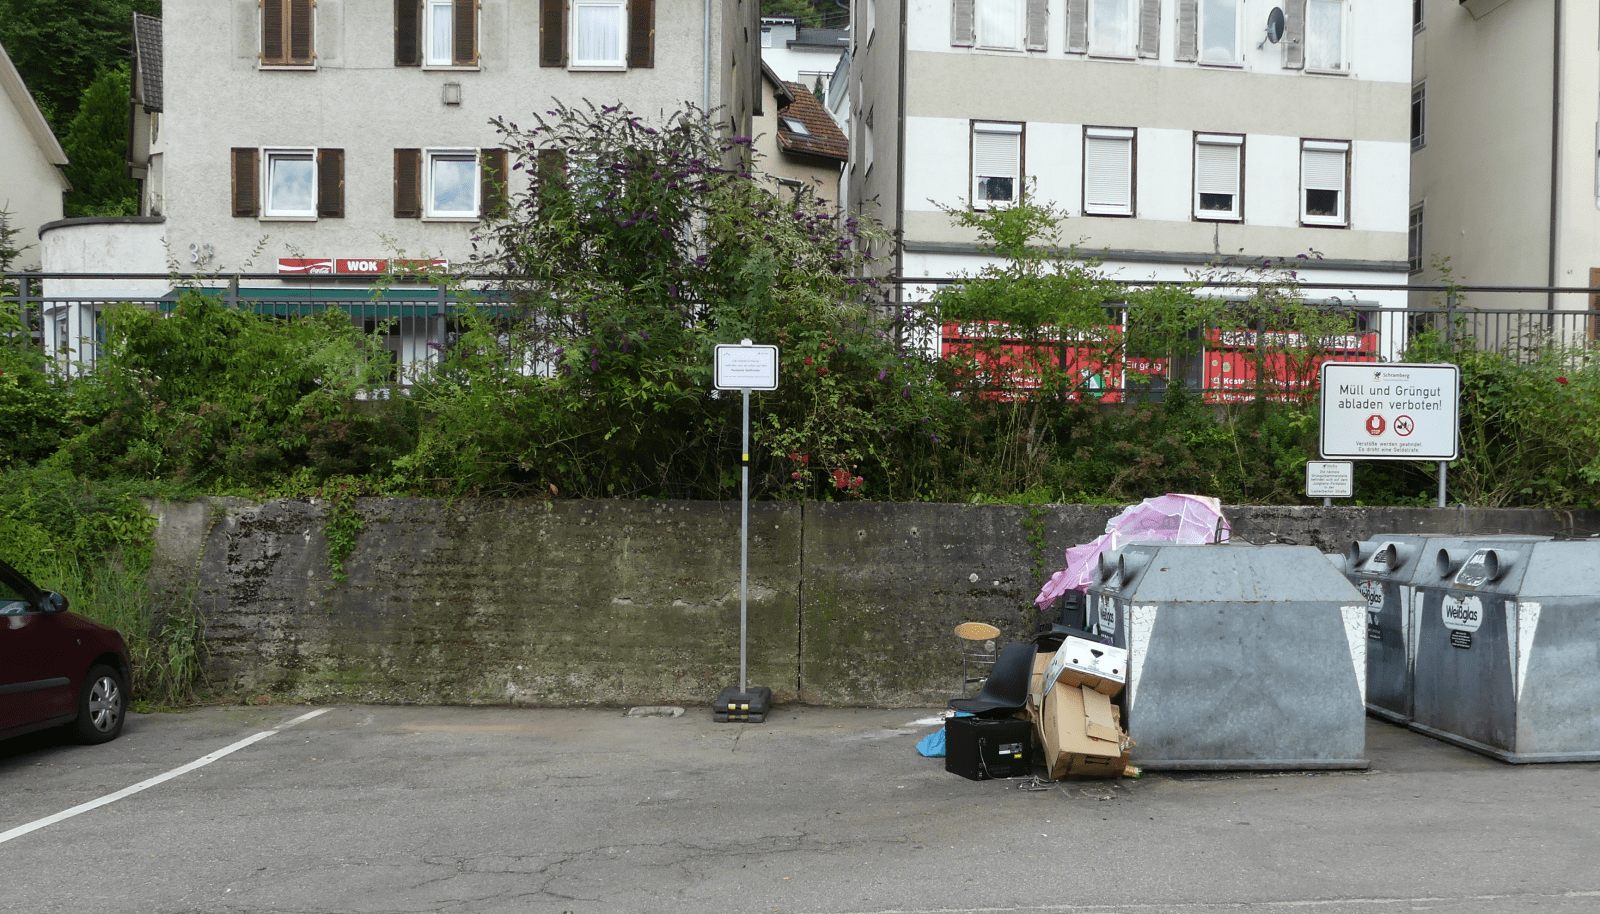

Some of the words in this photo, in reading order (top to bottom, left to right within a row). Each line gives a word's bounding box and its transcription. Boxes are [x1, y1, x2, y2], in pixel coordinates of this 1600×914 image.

[347, 261, 378, 271] WOK
[1340, 384, 1364, 396] Müll
[1370, 386, 1390, 396] und
[1396, 386, 1440, 399] Grüngut
[1338, 398, 1383, 409] abladen
[1389, 400, 1442, 410] verboten!
[1446, 604, 1478, 624] Weißglas
